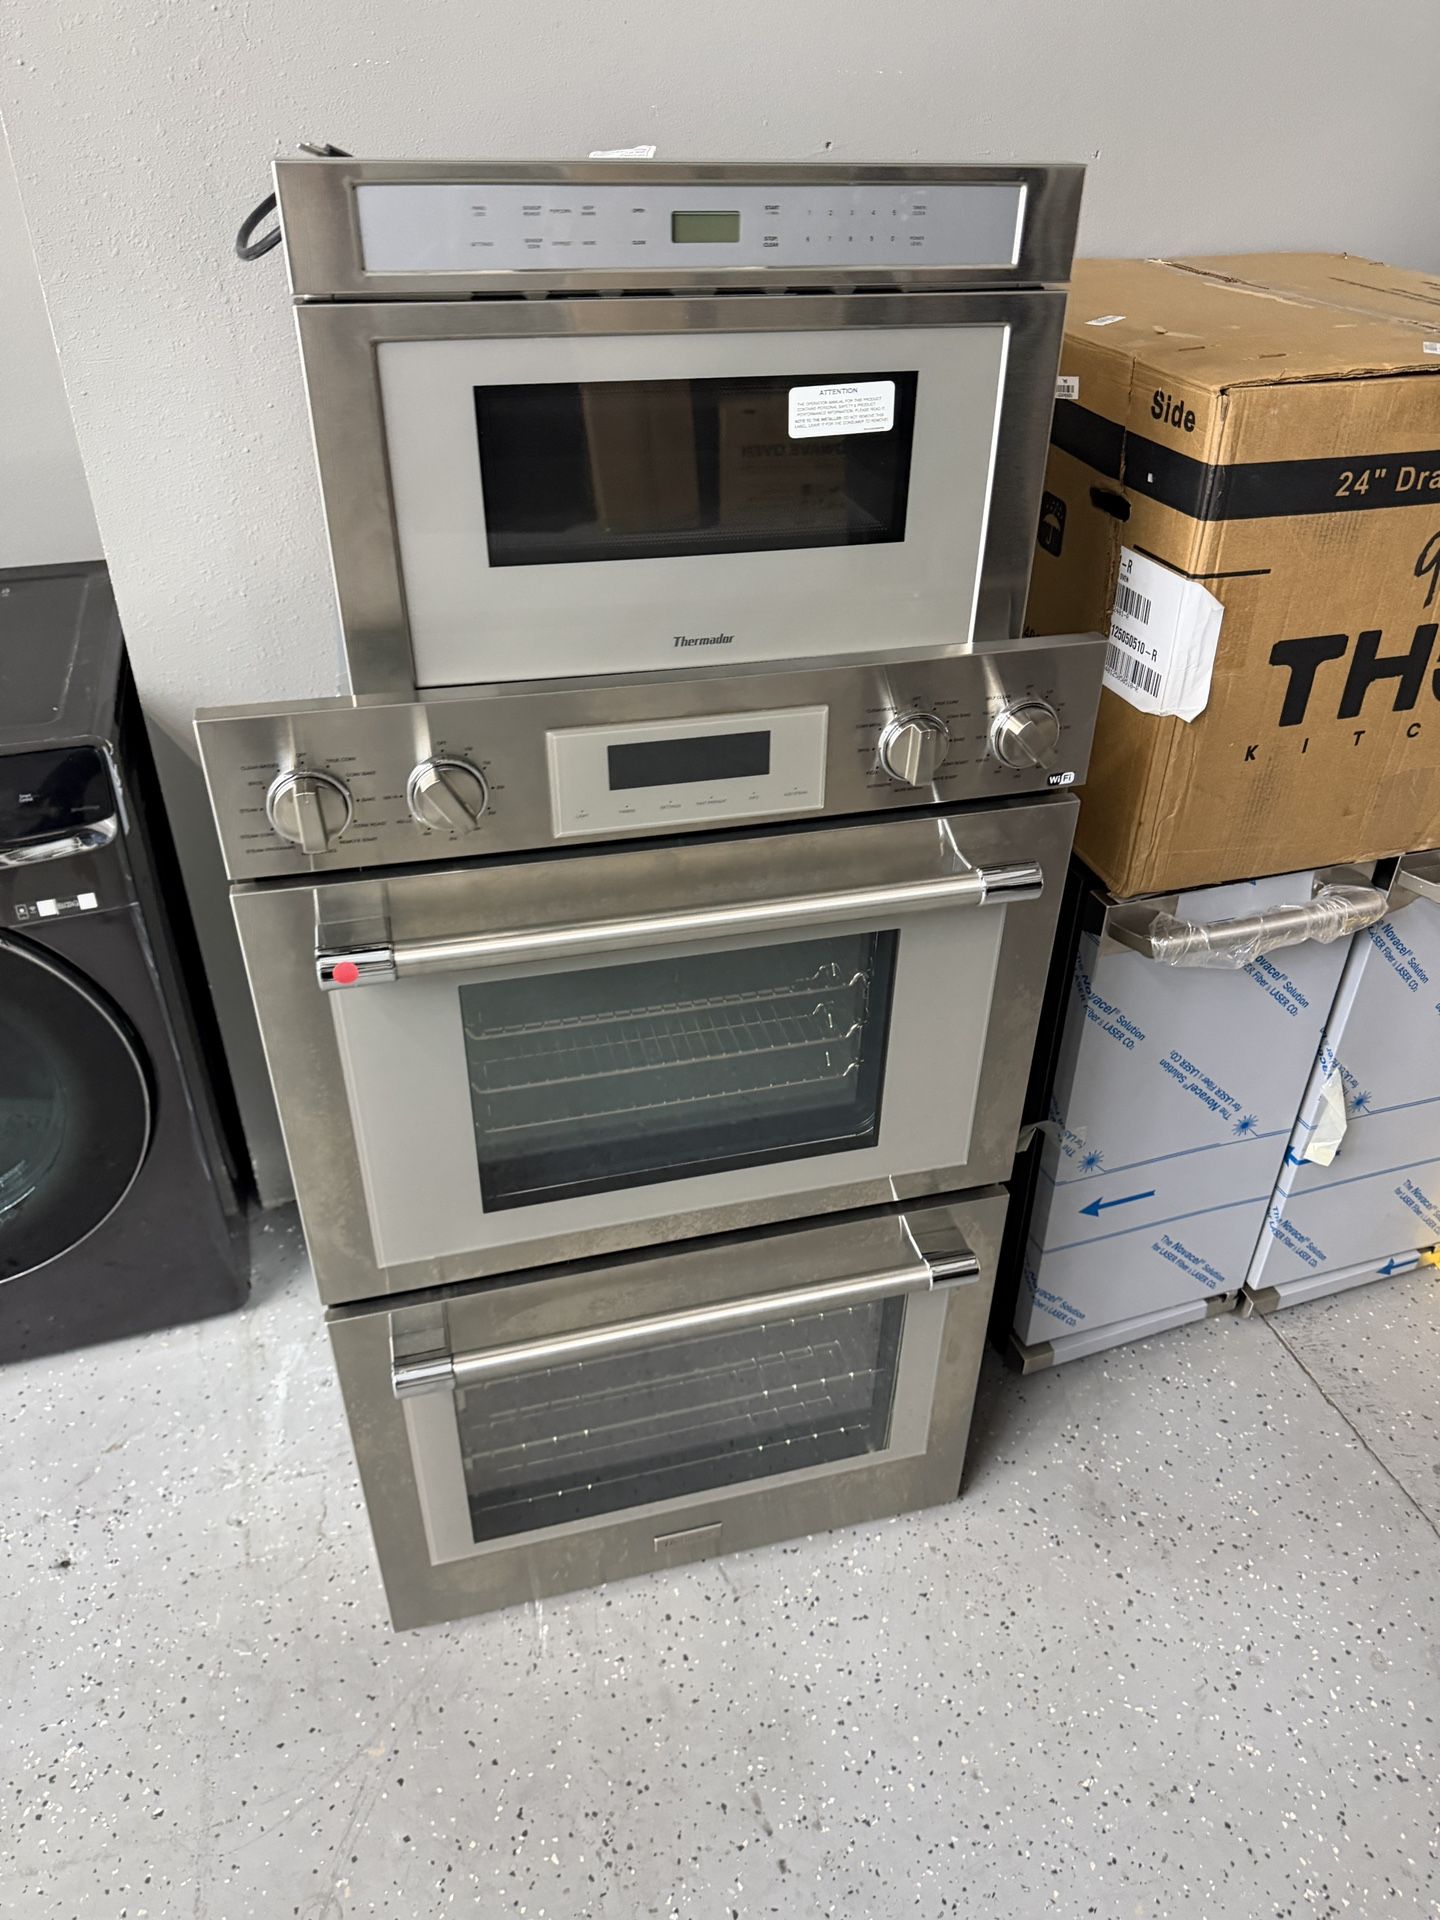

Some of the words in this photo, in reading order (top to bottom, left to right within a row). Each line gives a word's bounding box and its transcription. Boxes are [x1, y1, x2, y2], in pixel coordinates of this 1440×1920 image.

[819, 388, 858, 396] ATTENTION
[1150, 389, 1196, 433] Side
[1334, 468, 1388, 497] 24"
[673, 633, 736, 648] Thermador
[1268, 623, 1440, 727] TH
[1382, 946, 1396, 963] Fiber
[1394, 964, 1412, 982] LASER
[1408, 956, 1429, 984] Solution
[1252, 970, 1268, 988] Fiber
[1269, 987, 1289, 1008] LASER
[1254, 954, 1288, 981] ovacel®
[1282, 980, 1309, 1008] Solution
[1102, 1021, 1125, 1042] LASER
[1116, 1014, 1146, 1041] Solution
[1160, 1058, 1188, 1084] Solution
[1180, 1059, 1200, 1078] LASER
[1200, 1076, 1218, 1092] Fiber
[1214, 1087, 1235, 1106] LASER
[1218, 1106, 1232, 1120] The
[1232, 1102, 1242, 1112] for
[1160, 1234, 1173, 1246] The
[1203, 1262, 1226, 1282] Solution
